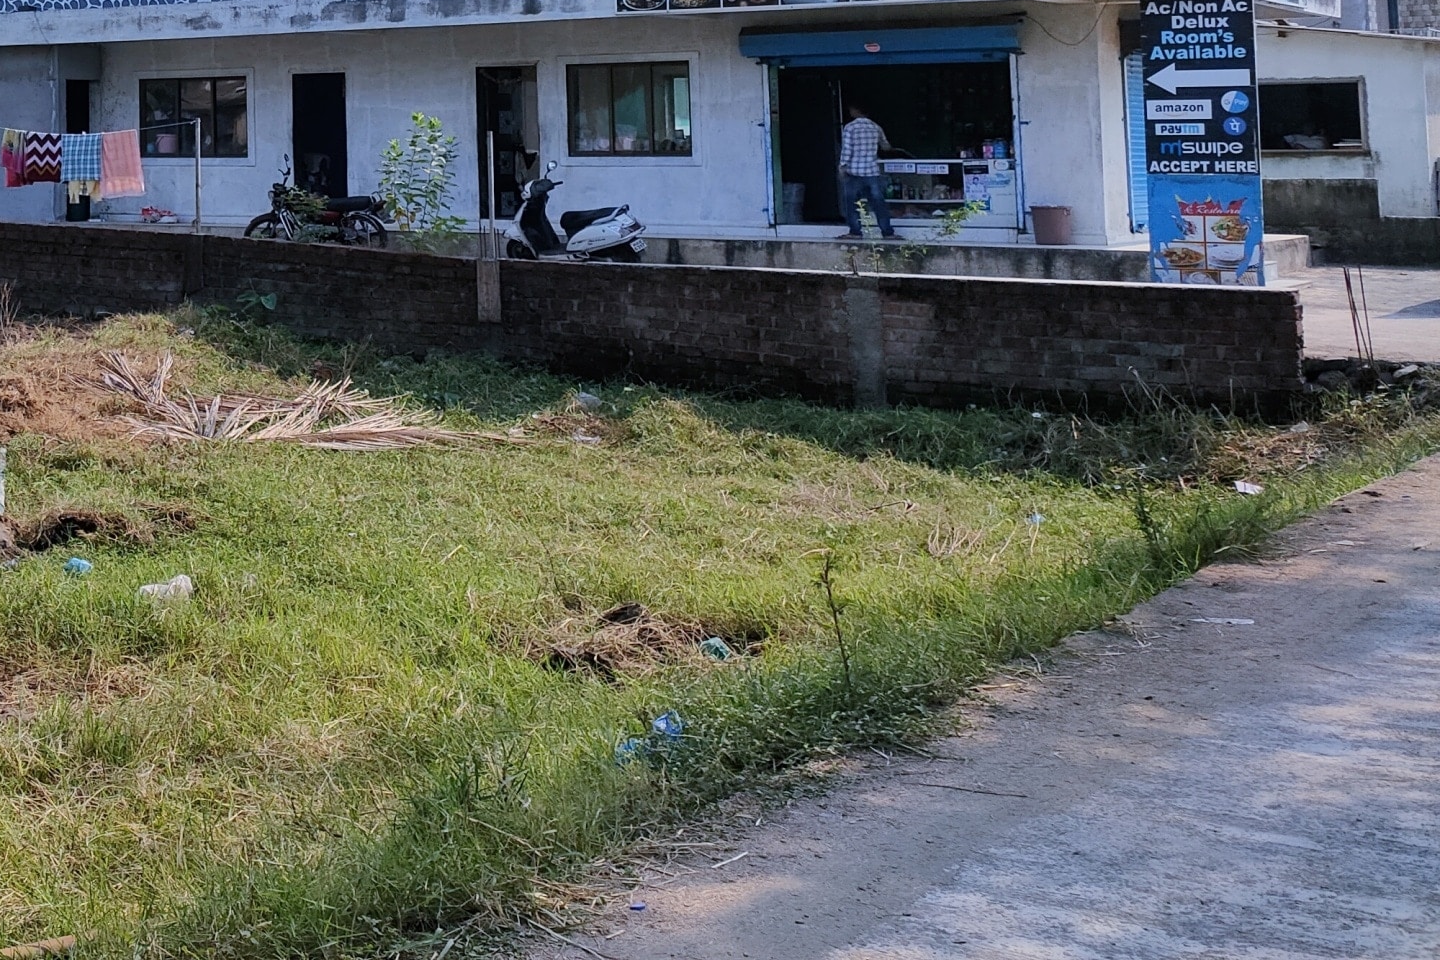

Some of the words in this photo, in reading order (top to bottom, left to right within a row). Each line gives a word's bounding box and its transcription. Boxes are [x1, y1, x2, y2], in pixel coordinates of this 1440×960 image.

[1145, 0, 1218, 16] Ac/Non
[1171, 15, 1229, 30] Delux
[1161, 29, 1234, 45] Room's
[1150, 44, 1247, 61] Available
[1155, 102, 1204, 113] amazon
[1149, 160, 1211, 173] ACCEPT
[1215, 160, 1257, 173] HERE
